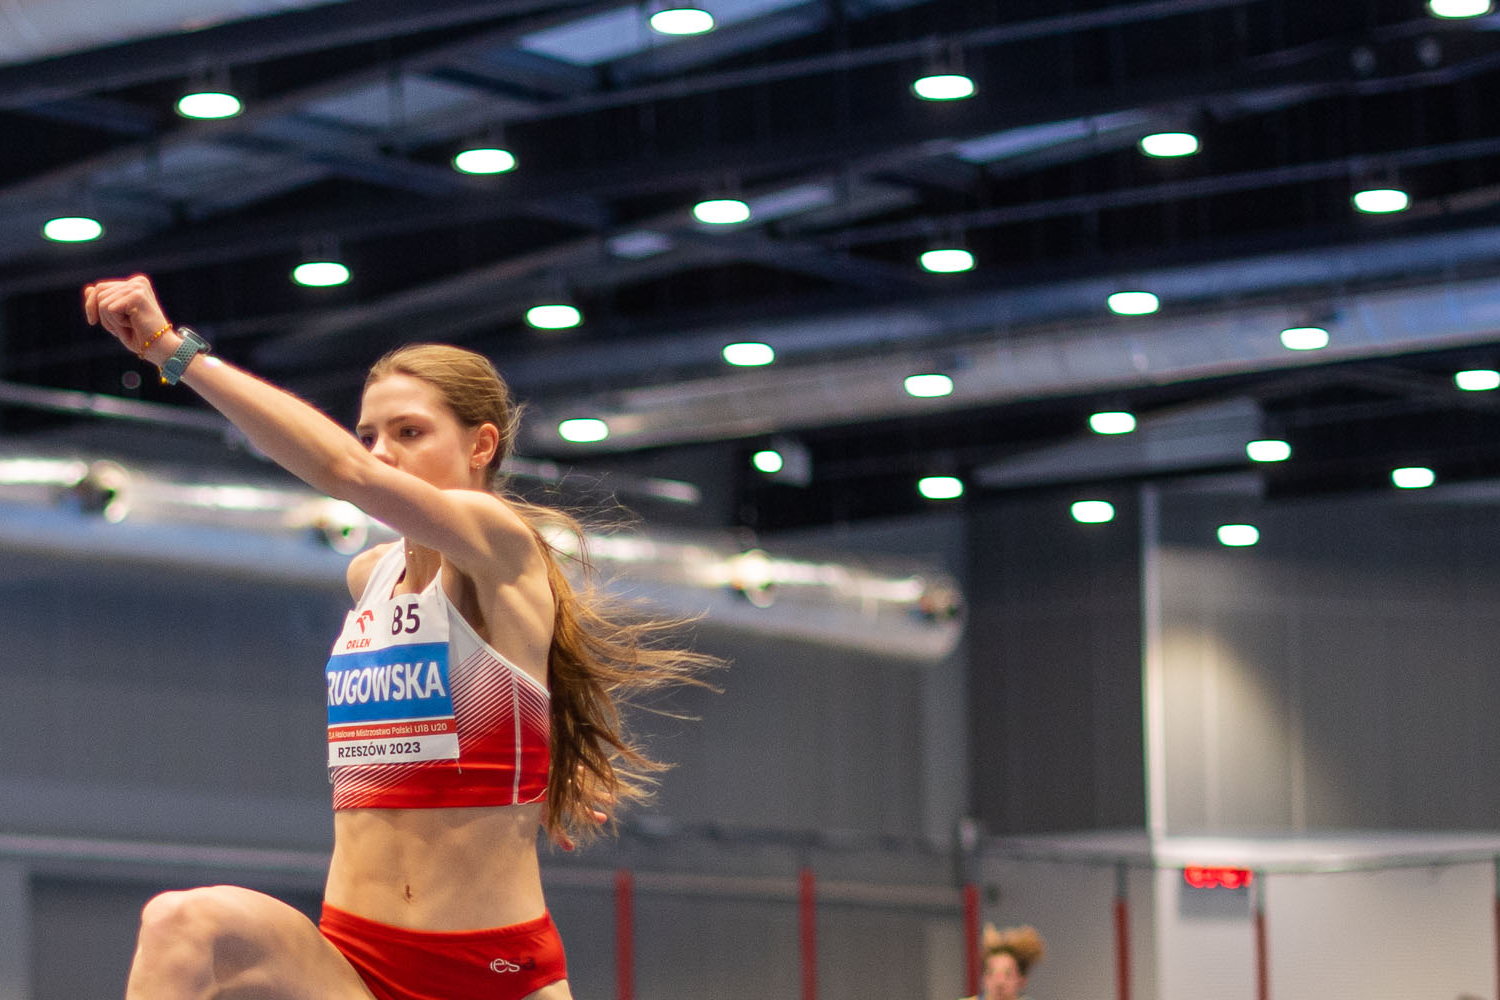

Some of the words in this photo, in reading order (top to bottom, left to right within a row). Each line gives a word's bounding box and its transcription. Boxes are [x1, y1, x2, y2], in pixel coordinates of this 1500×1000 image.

[392, 603, 420, 635] 85
[346, 638, 372, 650] ORLEN
[356, 727, 391, 737] Mistrzostwa
[392, 725, 413, 735] Polski
[414, 724, 429, 733] U18
[430, 722, 447, 732] U20
[338, 741, 387, 758] RZESZÓW
[389, 741, 421, 754] 2023
